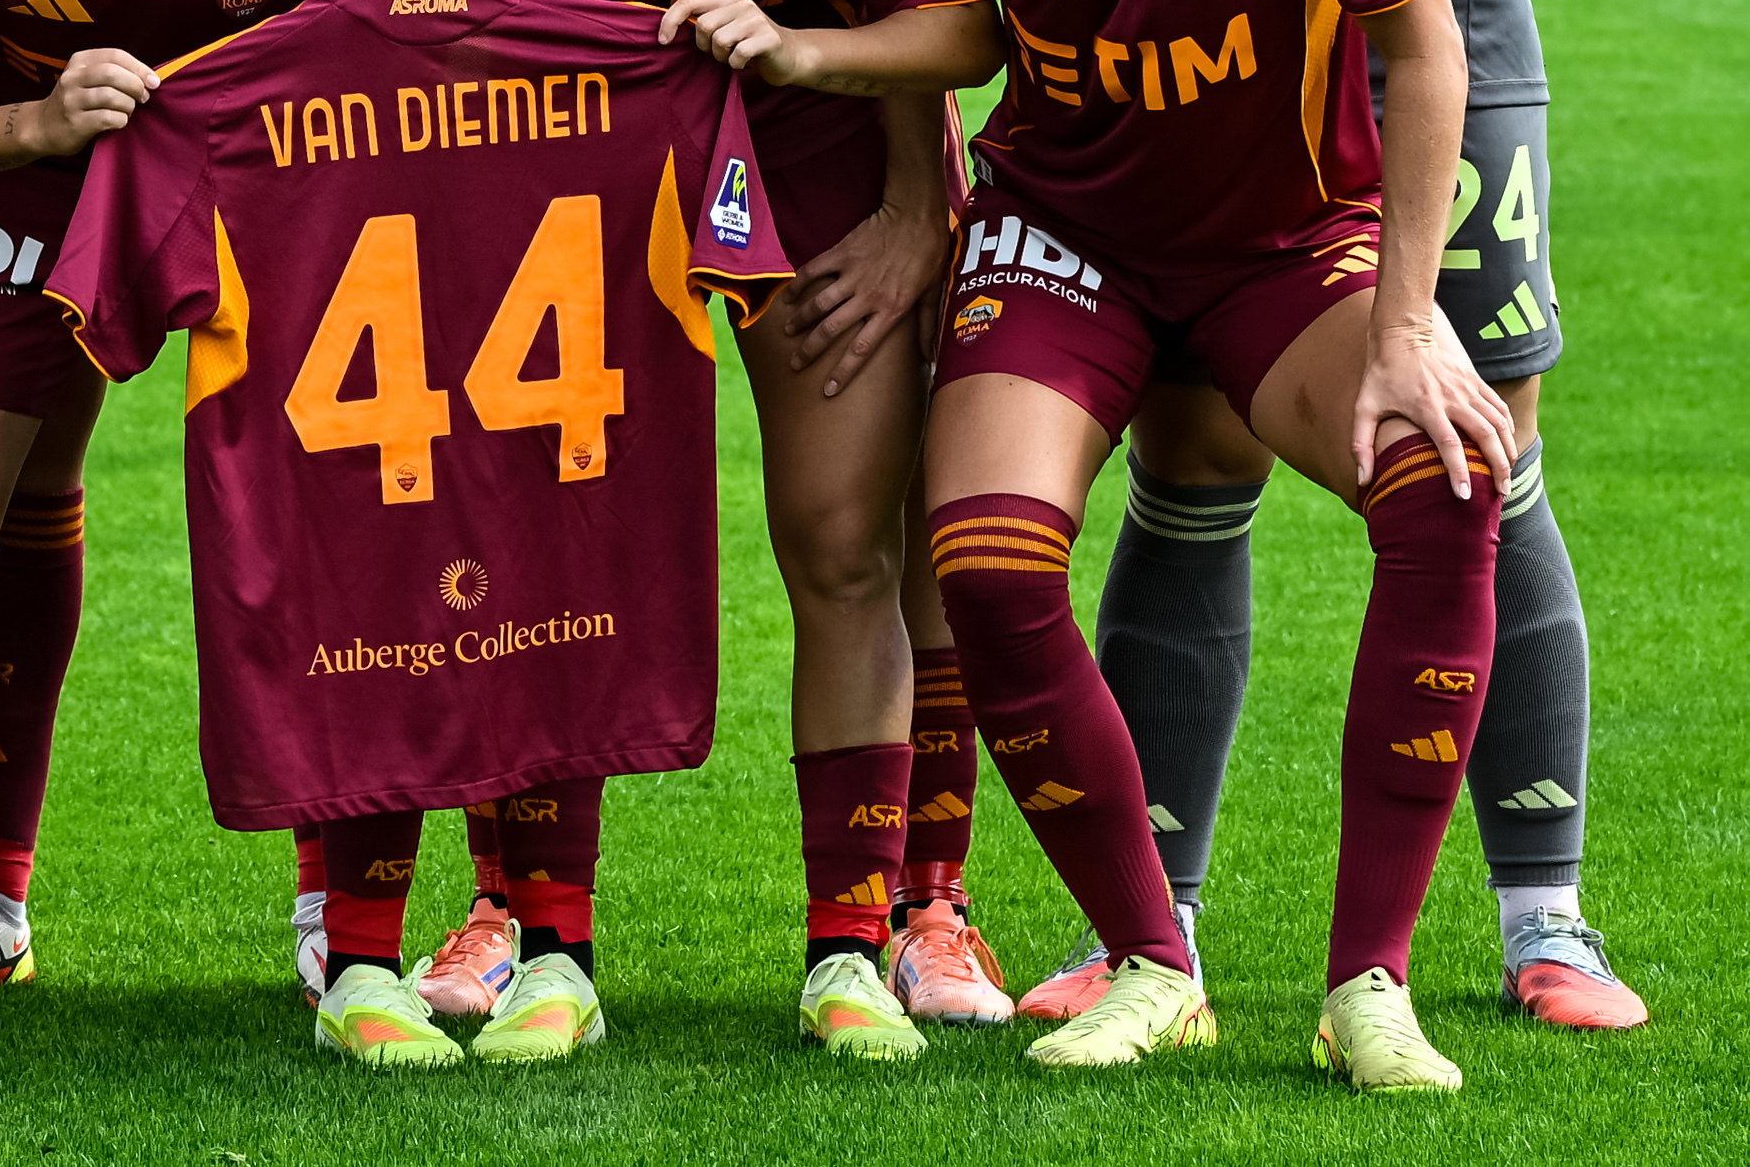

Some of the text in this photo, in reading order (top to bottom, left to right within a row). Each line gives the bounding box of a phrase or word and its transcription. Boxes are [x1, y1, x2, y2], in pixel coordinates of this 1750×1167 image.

[237, 7, 255, 18] 1927
[260, 72, 612, 168] VAN DIEMEN
[1438, 143, 1541, 270] 24
[959, 215, 1103, 291] HDI
[956, 270, 1098, 314] ASSICURAZIONI
[956, 323, 990, 340] ROMA
[284, 194, 625, 506] 44
[306, 610, 617, 677] Auberge Collection
[1414, 667, 1476, 693] ASR
[908, 730, 960, 754] SR
[993, 728, 1049, 754] ASR
[504, 798, 558, 823] ASR
[848, 804, 903, 829] ASR
[365, 858, 416, 881] ASR
